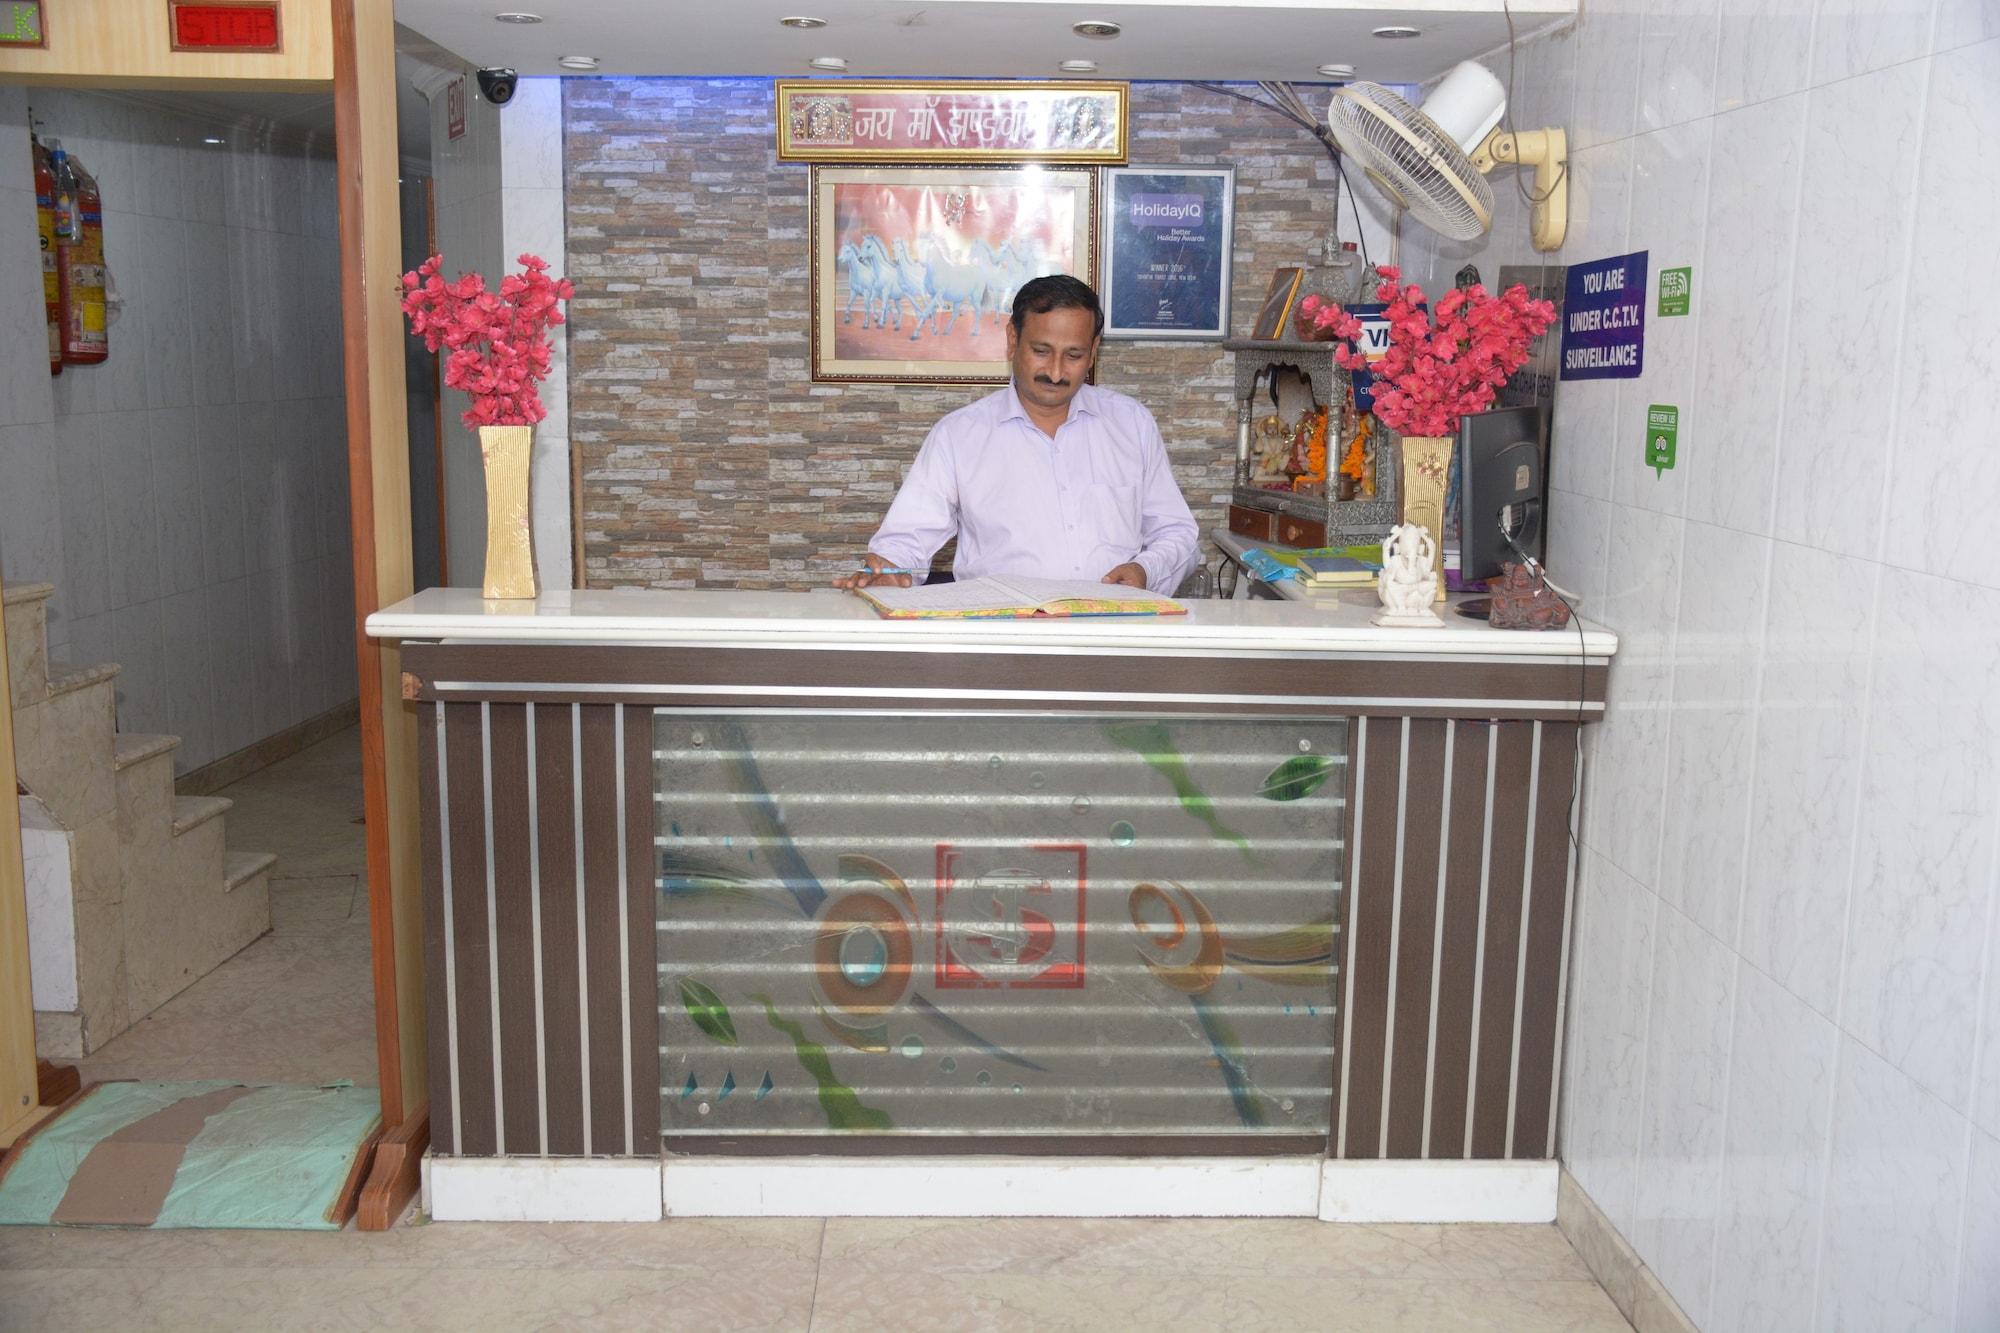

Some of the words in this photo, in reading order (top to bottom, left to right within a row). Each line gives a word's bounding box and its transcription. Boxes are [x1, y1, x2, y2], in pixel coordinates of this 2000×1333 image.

[855, 107, 897, 141] जय
[1133, 203, 1201, 220] HolidayIQ
[1583, 271, 1602, 294] YOU
[1604, 268, 1625, 291] ARE
[1662, 272, 1678, 286] FREE
[1570, 309, 1601, 333] UNDER
[1602, 304, 1639, 330] C.C.T.V.
[1566, 344, 1638, 369] SURVEILLANCE
